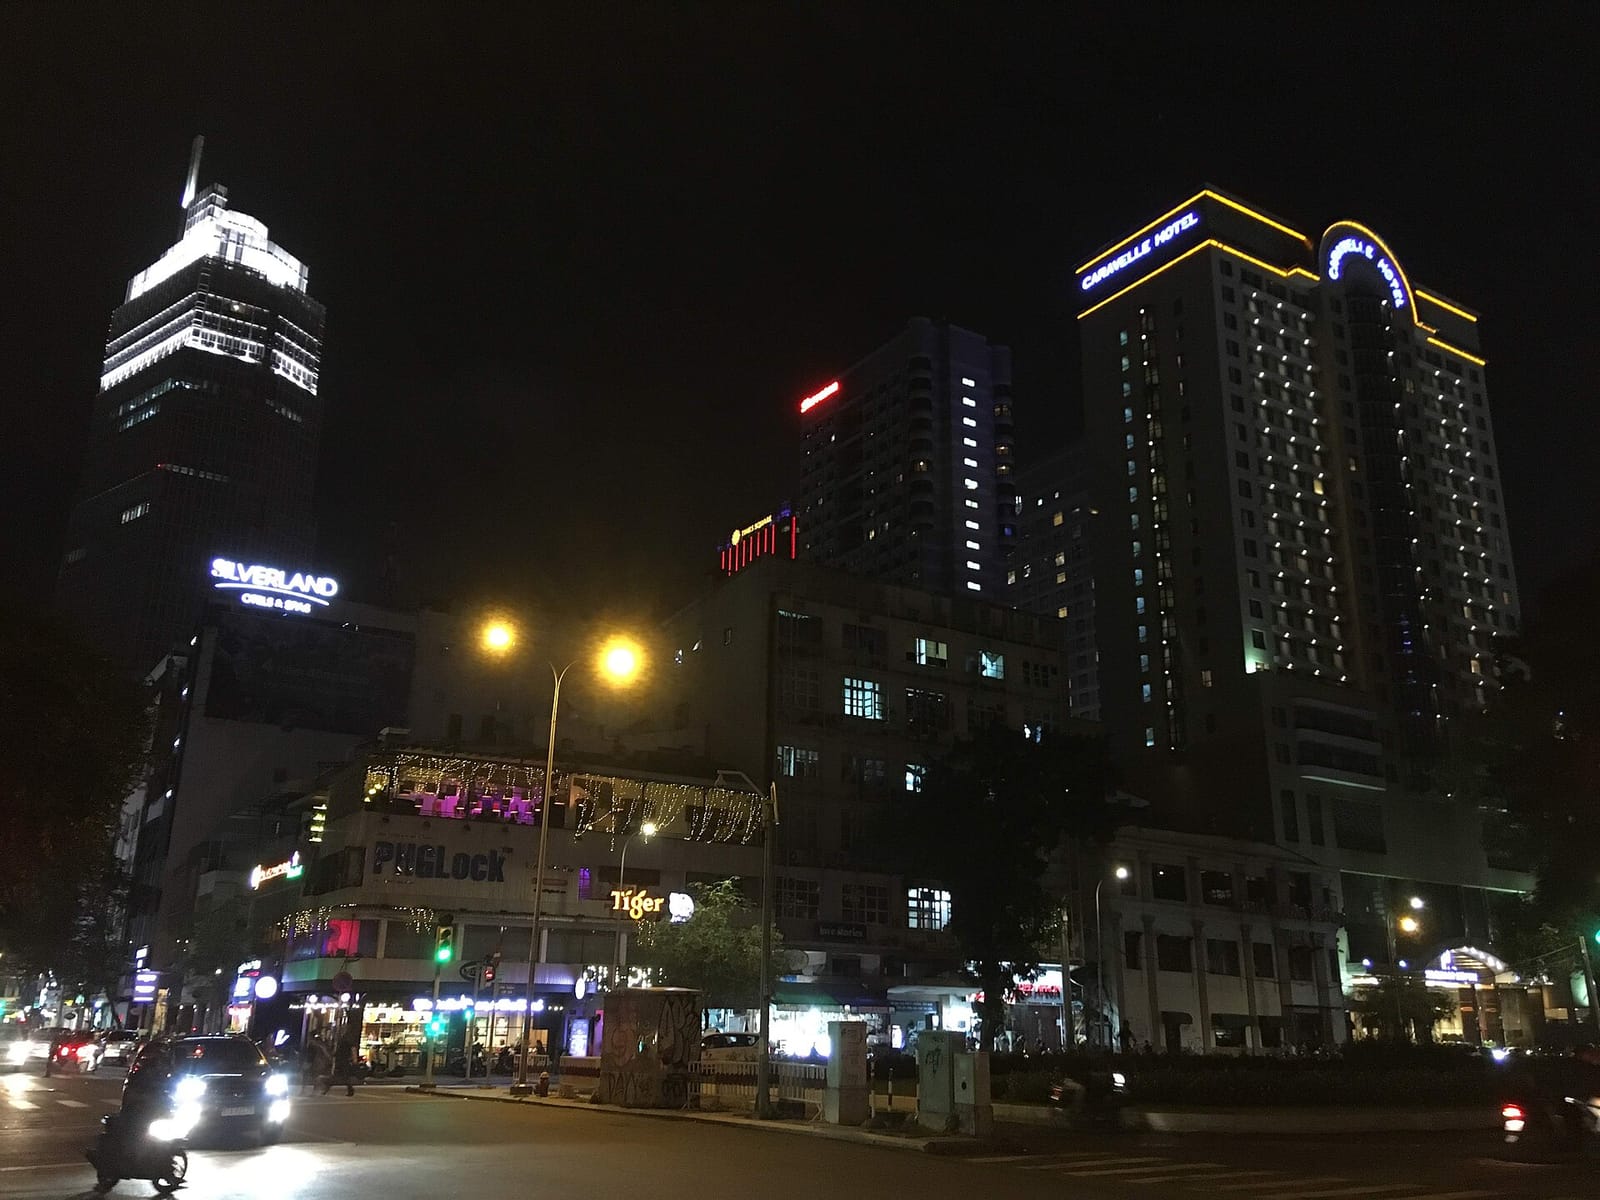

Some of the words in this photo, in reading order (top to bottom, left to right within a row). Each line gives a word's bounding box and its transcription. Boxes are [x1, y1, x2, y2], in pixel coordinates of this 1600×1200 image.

[1081, 239, 1151, 290] CARAVELLE
[1154, 212, 1199, 247] HOTEL
[210, 558, 338, 597] SILVERLAND
[610, 889, 665, 920] Tiger
